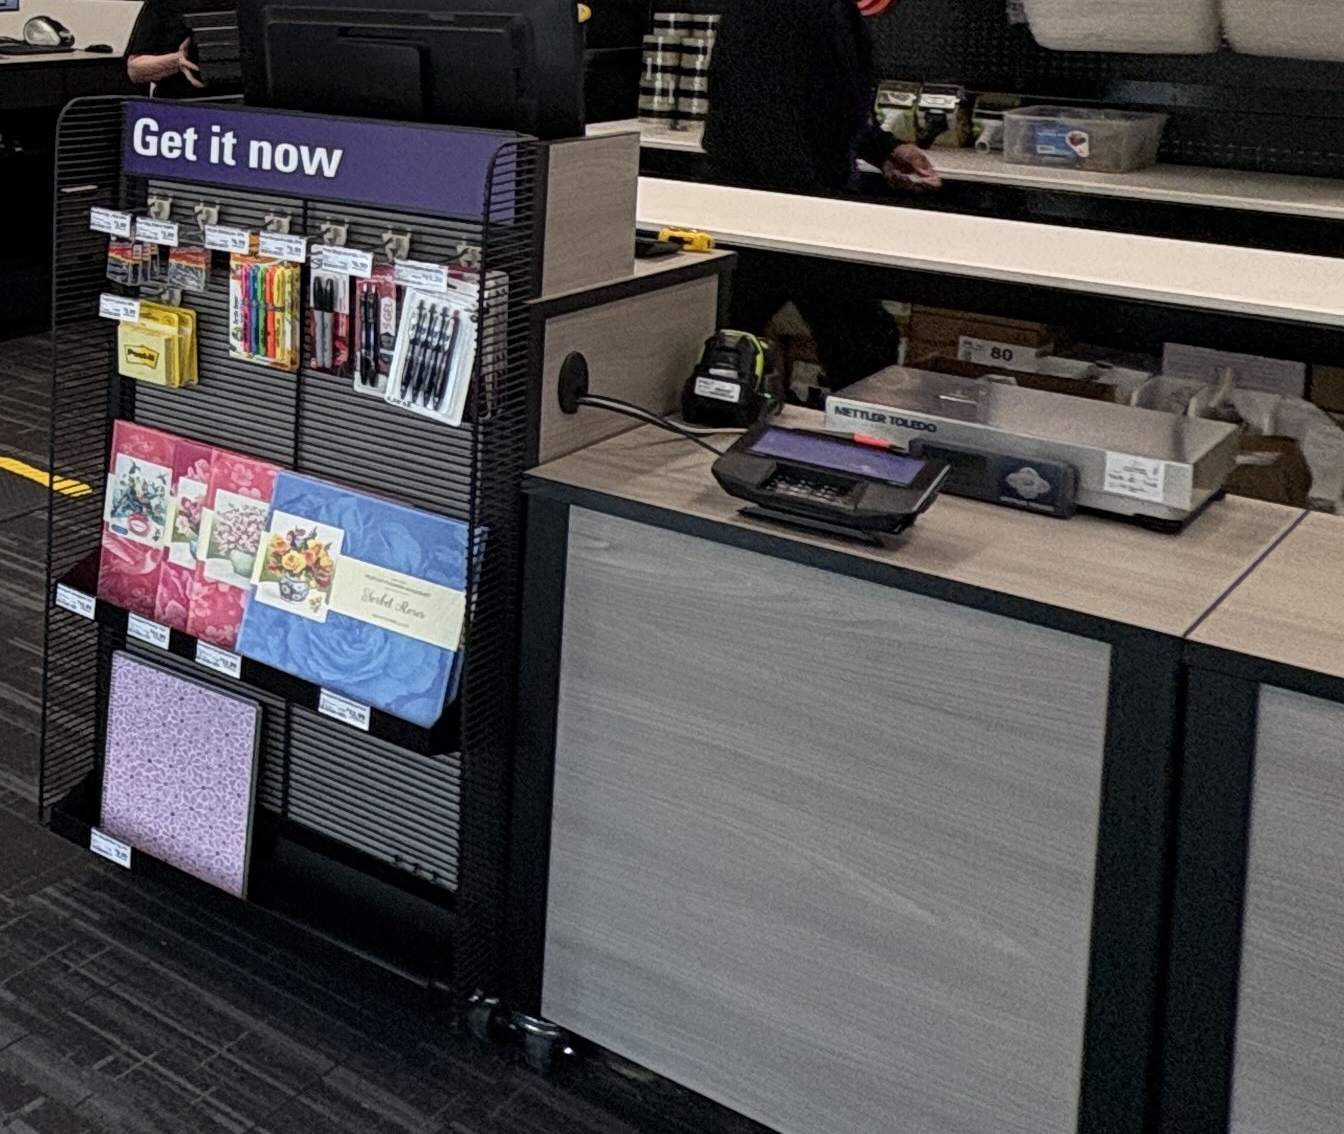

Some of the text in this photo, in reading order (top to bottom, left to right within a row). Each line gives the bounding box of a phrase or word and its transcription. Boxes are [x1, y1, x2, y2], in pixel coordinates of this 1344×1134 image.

[133, 117, 344, 179] Get it now
[990, 346, 1013, 362] 80
[835, 406, 937, 433] METTLER TOLEDO
